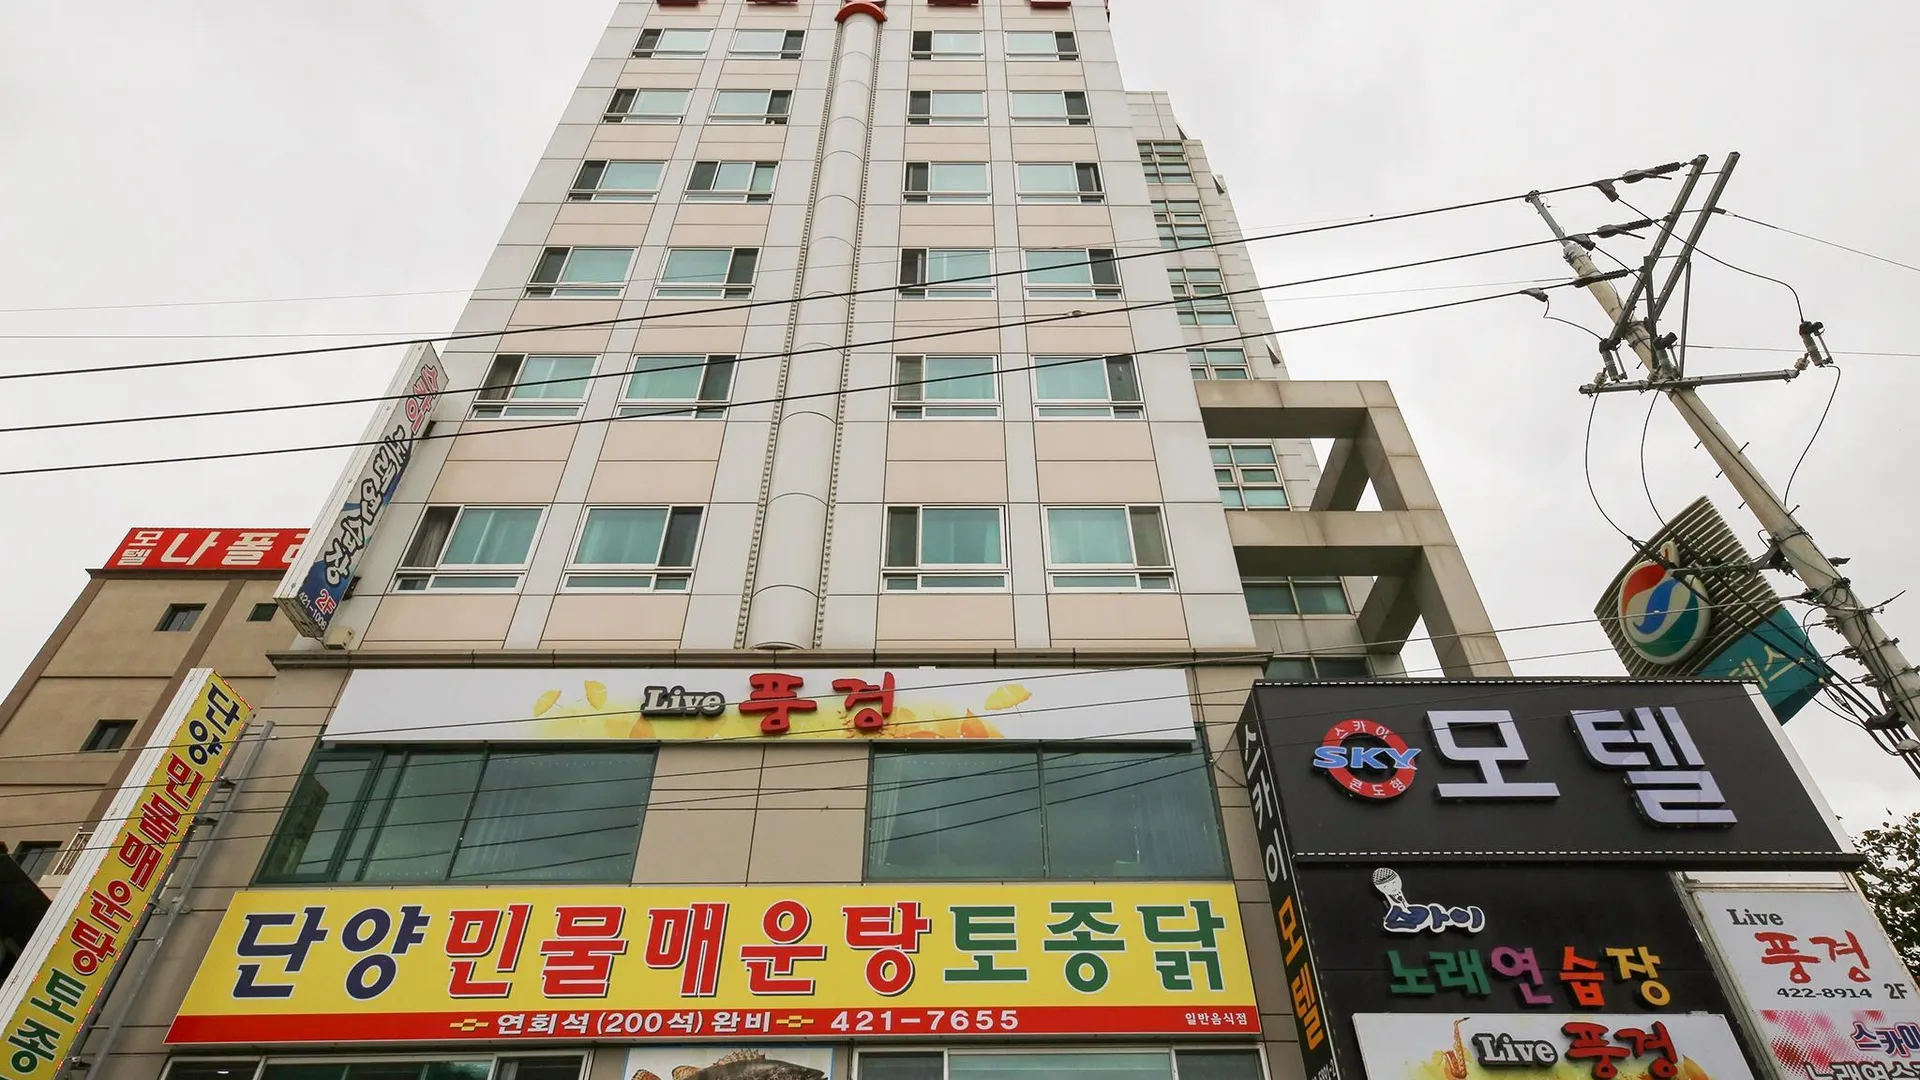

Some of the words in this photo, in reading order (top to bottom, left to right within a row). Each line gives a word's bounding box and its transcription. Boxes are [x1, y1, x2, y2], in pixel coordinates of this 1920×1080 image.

[324, 424, 407, 587] 노래연습장
[117, 531, 163, 565] 모텔
[315, 588, 337, 615] 2F
[641, 685, 725, 717] Live
[738, 671, 896, 735] 풍경
[187, 681, 240, 767] 단양
[1334, 720, 1390, 740] 스카이
[1313, 745, 1422, 770] SKY
[1426, 706, 1739, 826] 모텔
[1349, 778, 1407, 796] 콘도형
[70, 752, 205, 976] 민물매운탕
[1245, 724, 1288, 883] 스카이
[1278, 895, 1325, 1050] 모텔
[1726, 909, 1784, 926] Live
[1754, 930, 1871, 984] 풍경
[1387, 946, 1671, 1006] 노래연습장
[1776, 987, 1873, 999] 422-8914
[1884, 983, 1909, 1000] 2F
[0, 967, 88, 1080] 토종
[830, 1009, 1020, 1032] 421-7655
[1184, 1011, 1249, 1026] 일반음식점
[1472, 1032, 1558, 1068] Live
[1561, 1020, 1679, 1080] 풍경
